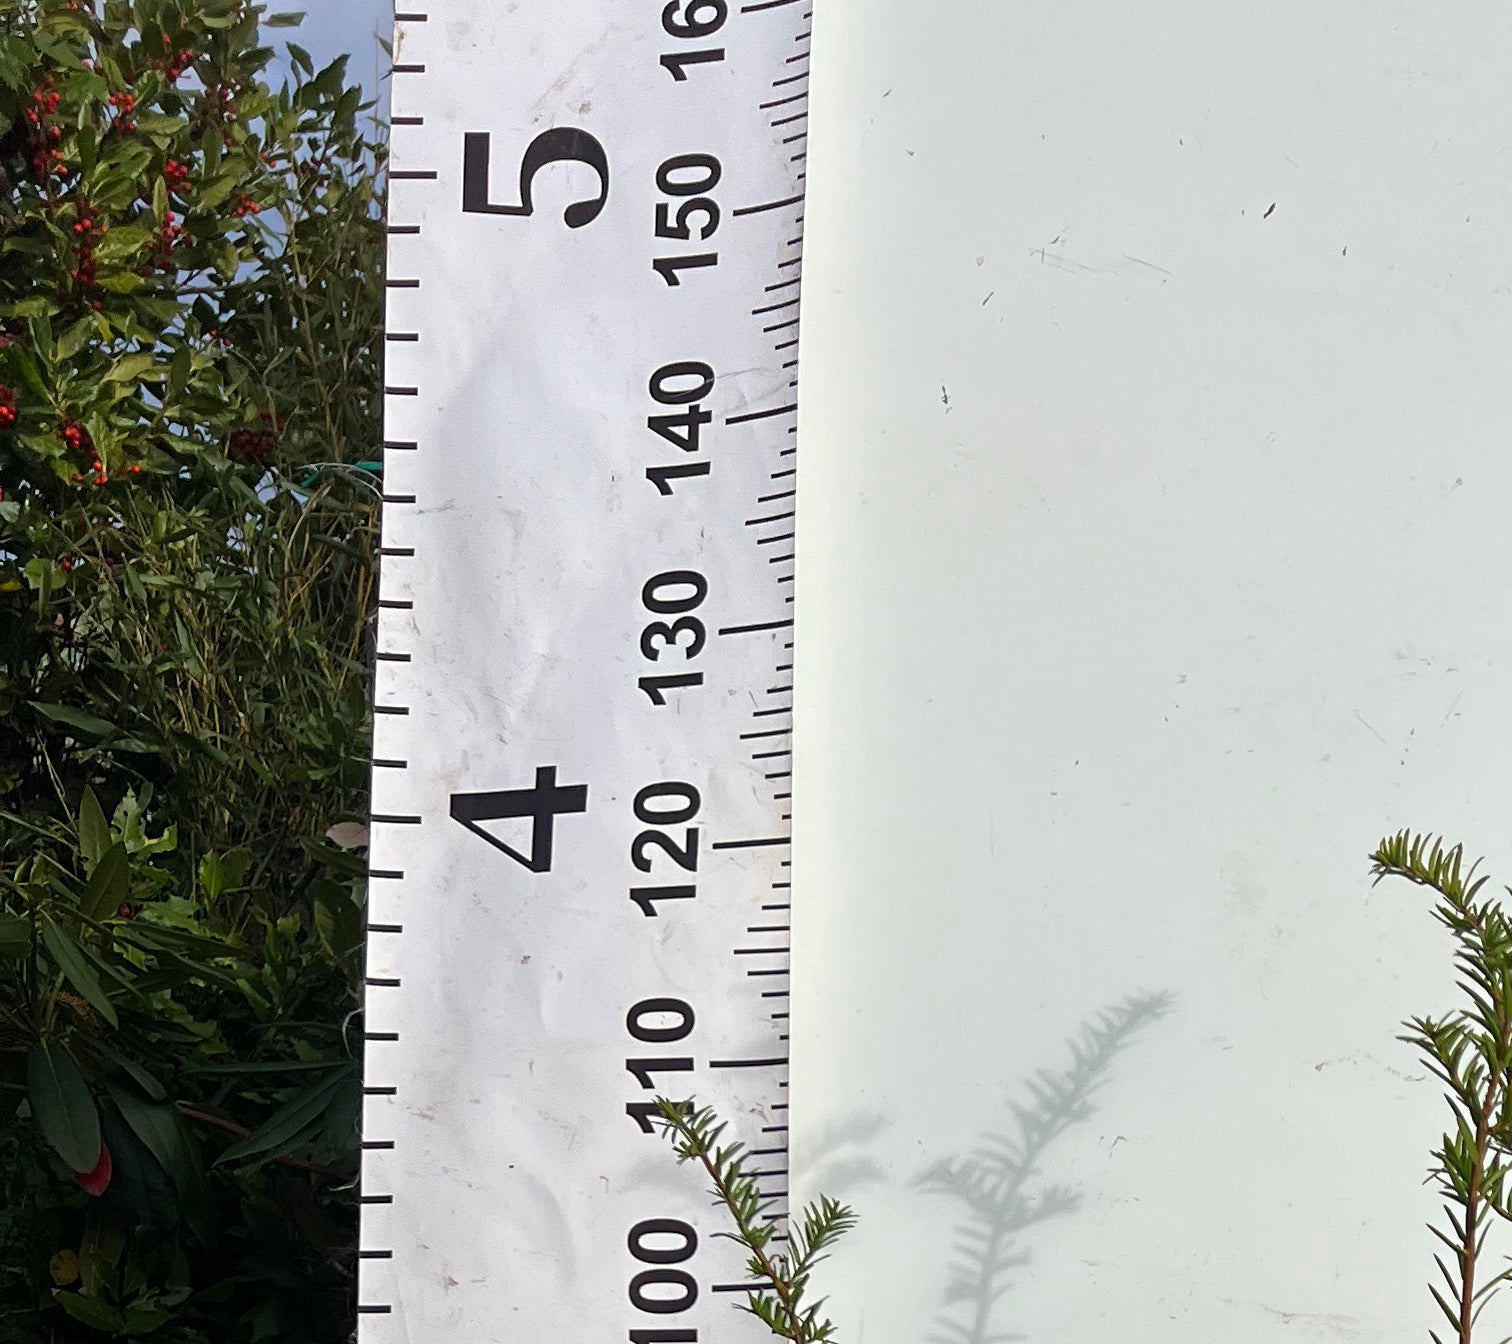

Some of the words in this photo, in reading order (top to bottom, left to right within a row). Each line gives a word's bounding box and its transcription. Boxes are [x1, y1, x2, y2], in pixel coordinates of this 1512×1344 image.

[461, 126, 610, 230] 5
[652, 153, 722, 287] 150
[645, 361, 715, 497] 140
[637, 569, 708, 706] 130
[449, 765, 589, 874] 4
[629, 781, 702, 918] 120
[625, 997, 696, 1135] 110
